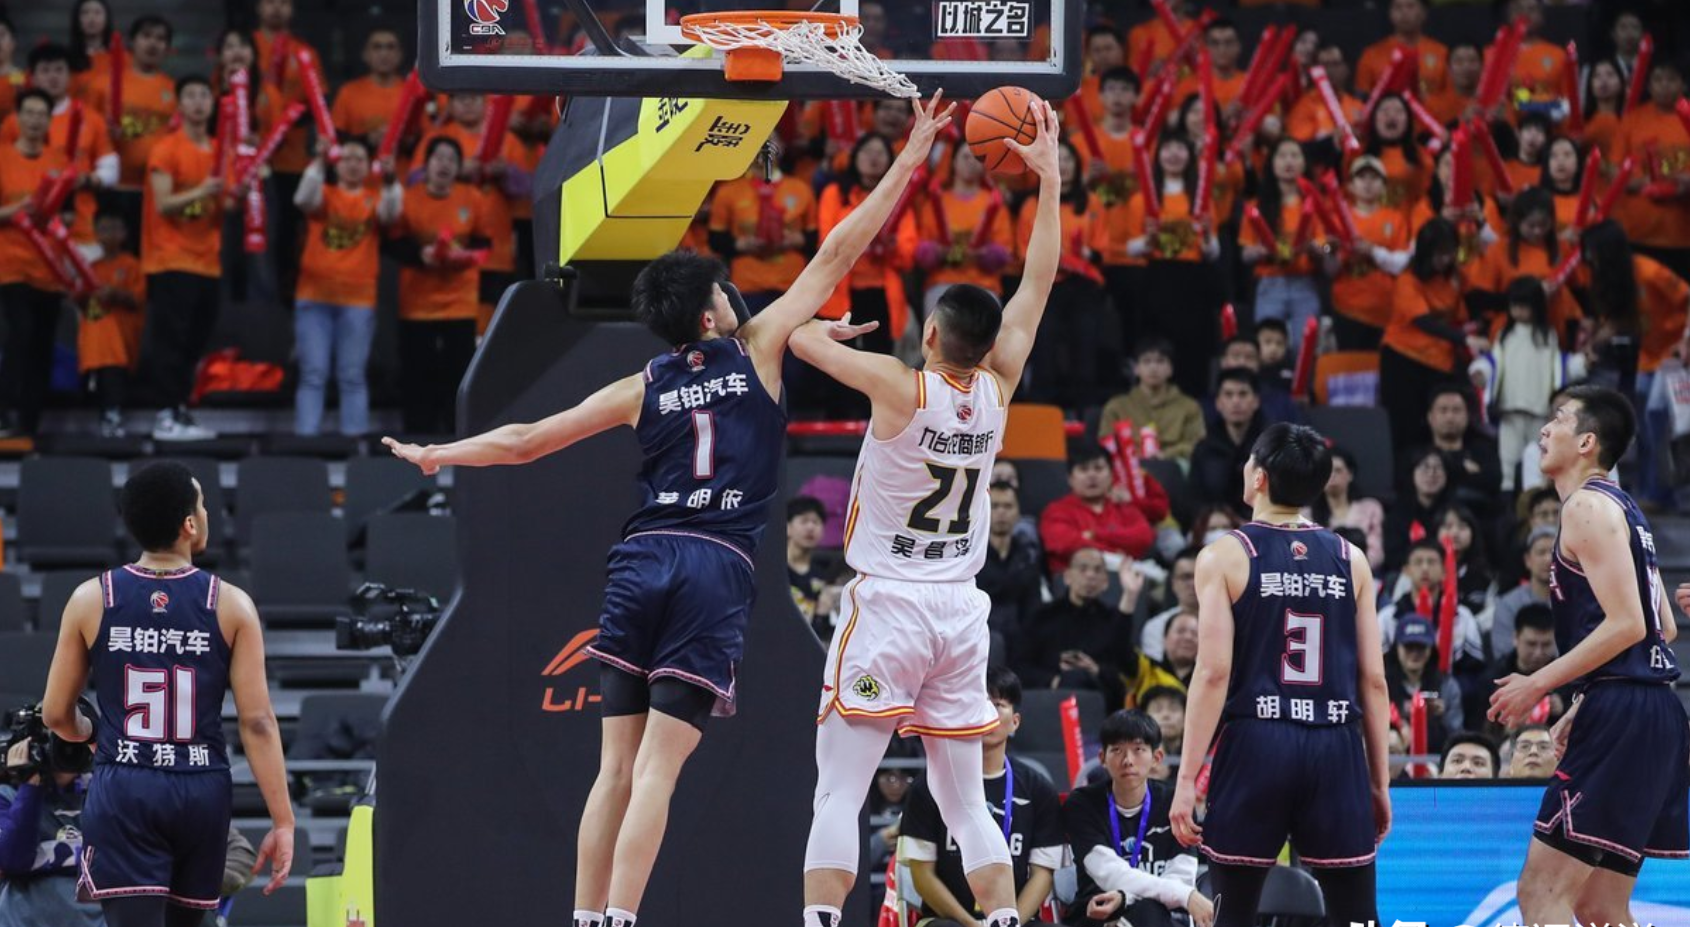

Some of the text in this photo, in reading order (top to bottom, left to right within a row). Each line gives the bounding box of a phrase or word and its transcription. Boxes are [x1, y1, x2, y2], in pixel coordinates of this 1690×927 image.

[469, 23, 506, 35] CBA
[939, 2, 1028, 35] 以城之名
[658, 372, 749, 415] 昊铂汽车
[691, 409, 715, 480] 1
[906, 460, 981, 534] 21
[1259, 572, 1347, 599] 昊铂汽车
[107, 626, 211, 656] 昊铂汽车
[1281, 608, 1324, 685] 3
[124, 663, 196, 743] 51
[1256, 696, 1350, 724] 胡明轩
[115, 739, 210, 767] 沃特斯
